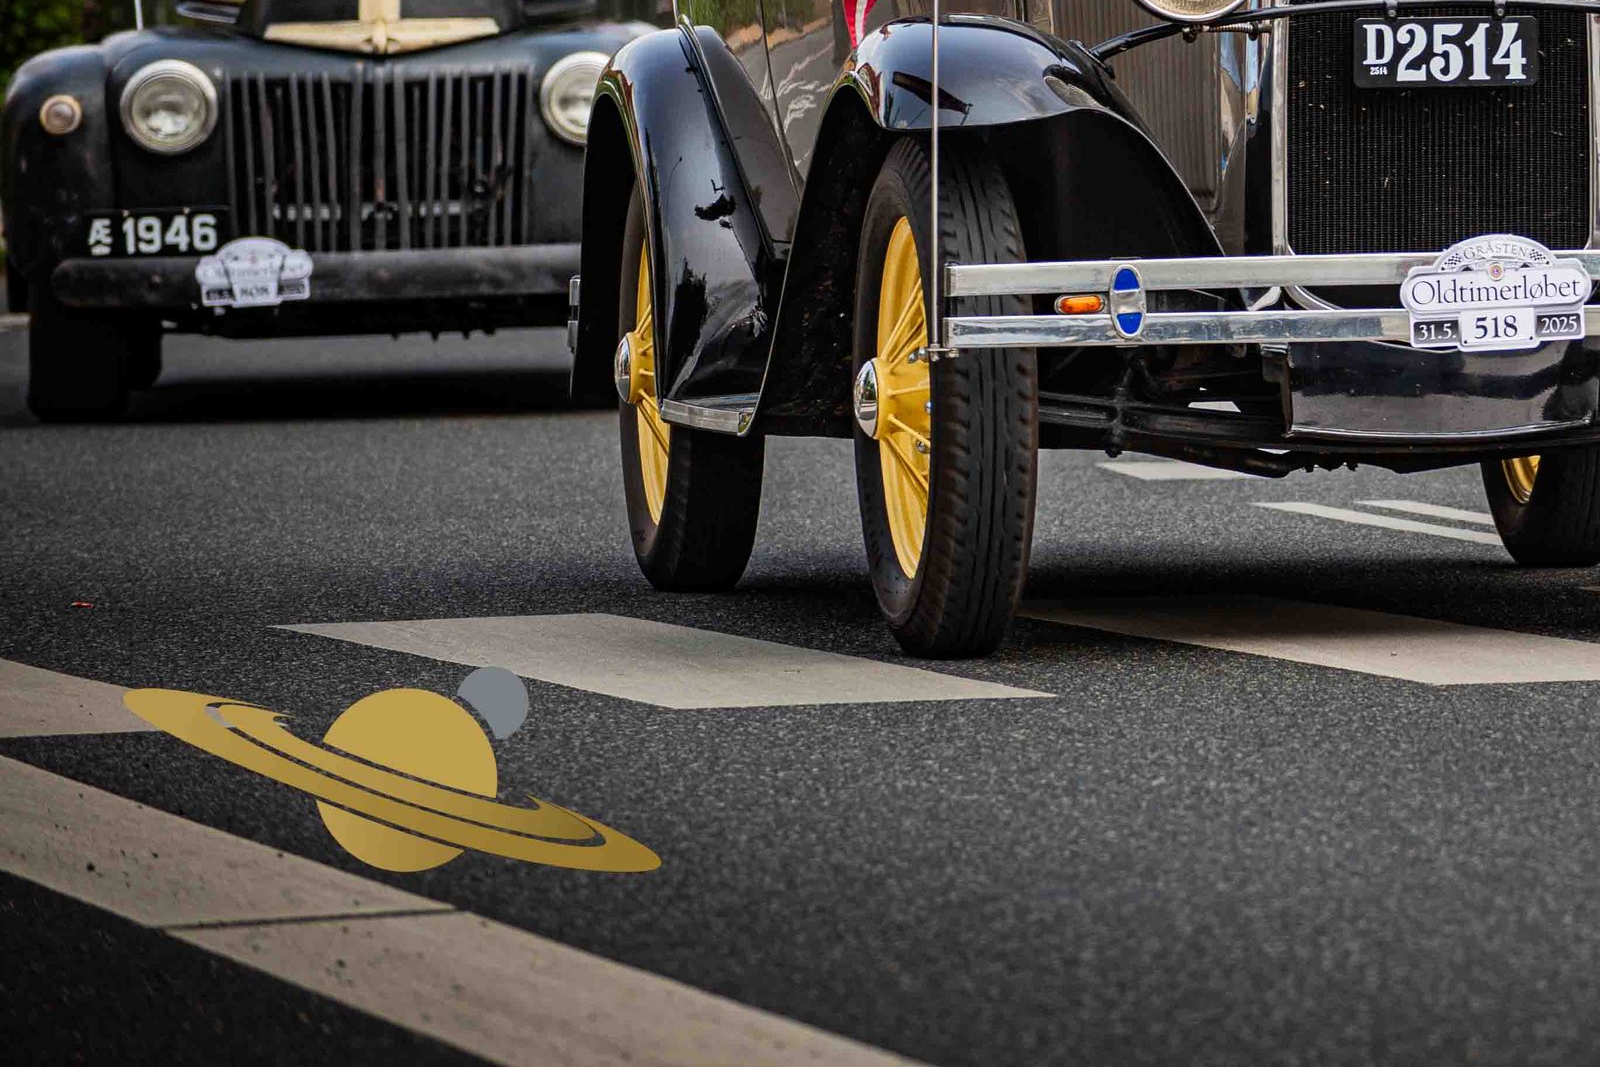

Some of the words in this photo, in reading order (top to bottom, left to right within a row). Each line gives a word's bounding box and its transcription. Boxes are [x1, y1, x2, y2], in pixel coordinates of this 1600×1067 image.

[1369, 66, 1388, 76] 2514
[121, 213, 218, 255] 1946
[1411, 273, 1582, 305] Oldtimerløbet
[1418, 323, 1457, 340] 31.5.
[1474, 314, 1518, 340] 518
[1540, 315, 1578, 334] 2025
